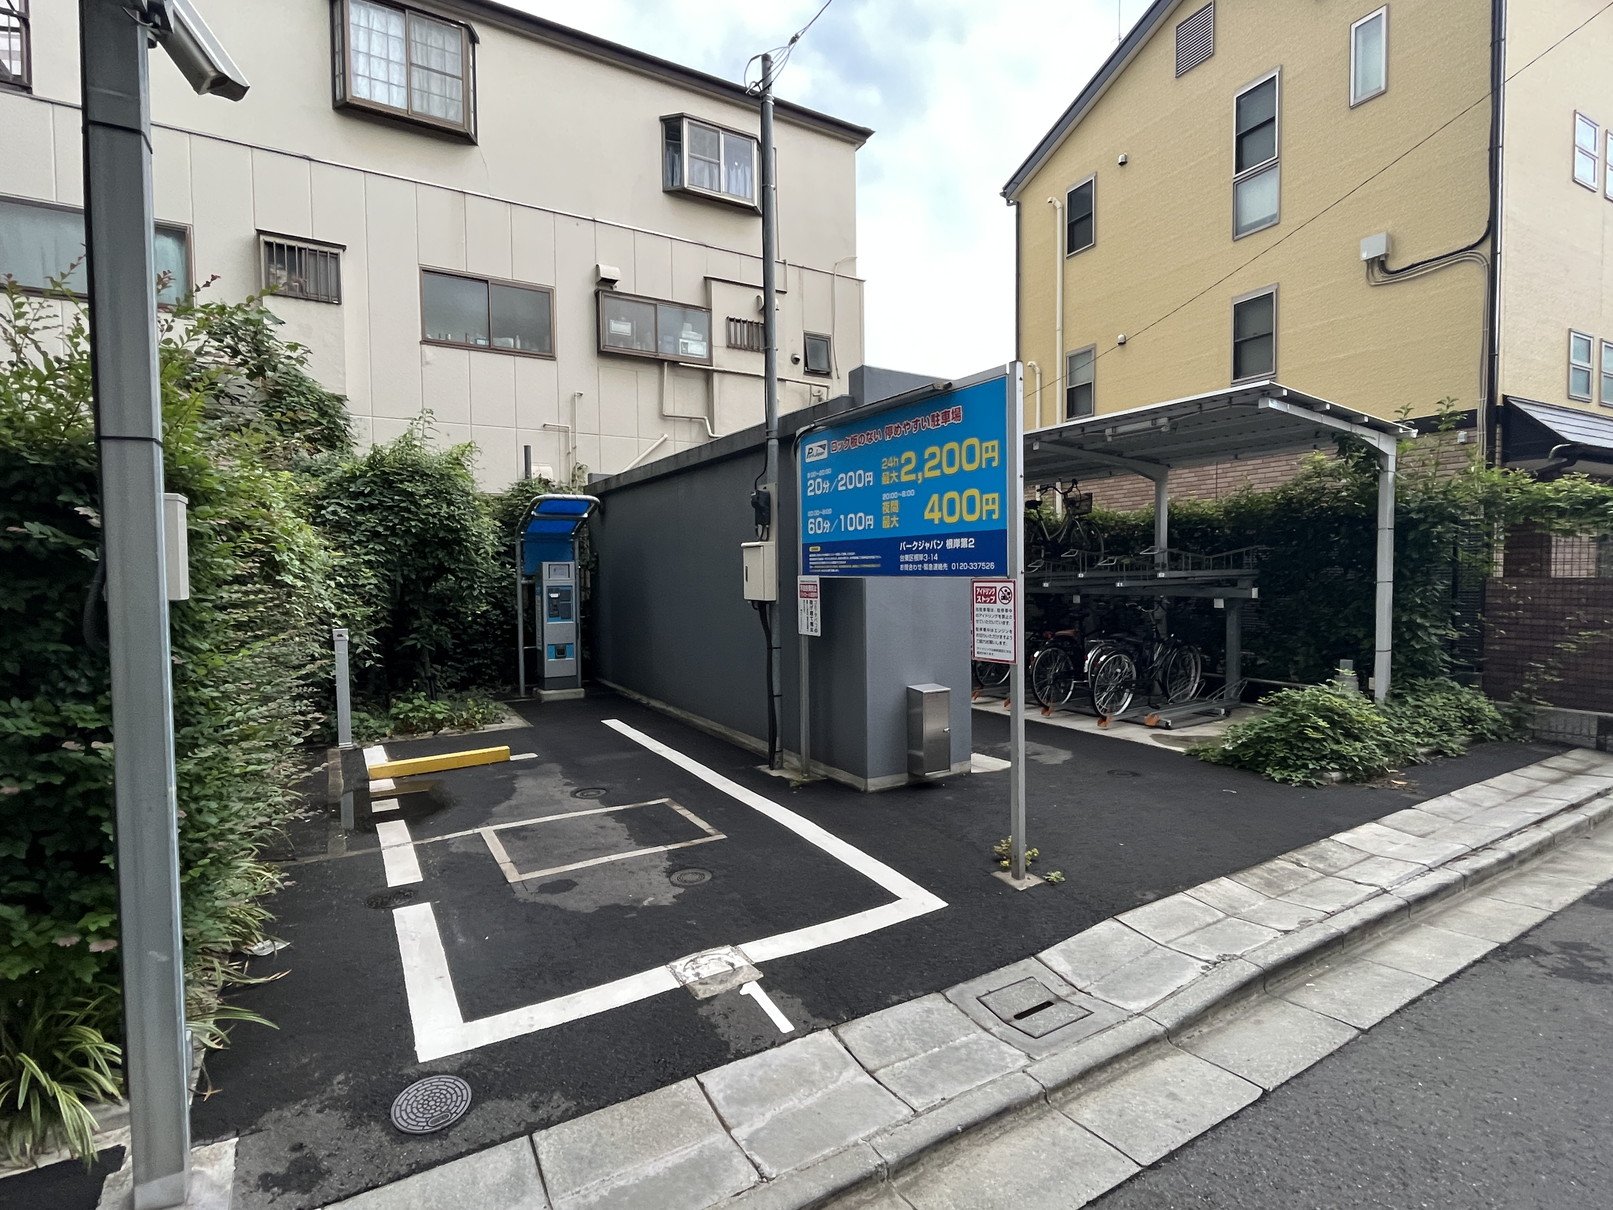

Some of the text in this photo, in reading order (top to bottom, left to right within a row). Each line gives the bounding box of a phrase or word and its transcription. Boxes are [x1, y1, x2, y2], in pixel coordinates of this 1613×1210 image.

[884, 405, 962, 441] 停めやすい駐車場
[881, 455, 899, 470] 24h
[900, 437, 999, 484] 2,200円
[882, 470, 899, 485] 最大
[882, 500, 899, 515] 夜間
[924, 488, 999, 525] 400円
[882, 514, 899, 530] 最大
[899, 541, 943, 551] パークジャパン
[976, 587, 996, 595] アイドリング
[976, 595, 995, 603] ストップ
[739, 980, 795, 1034] 1
